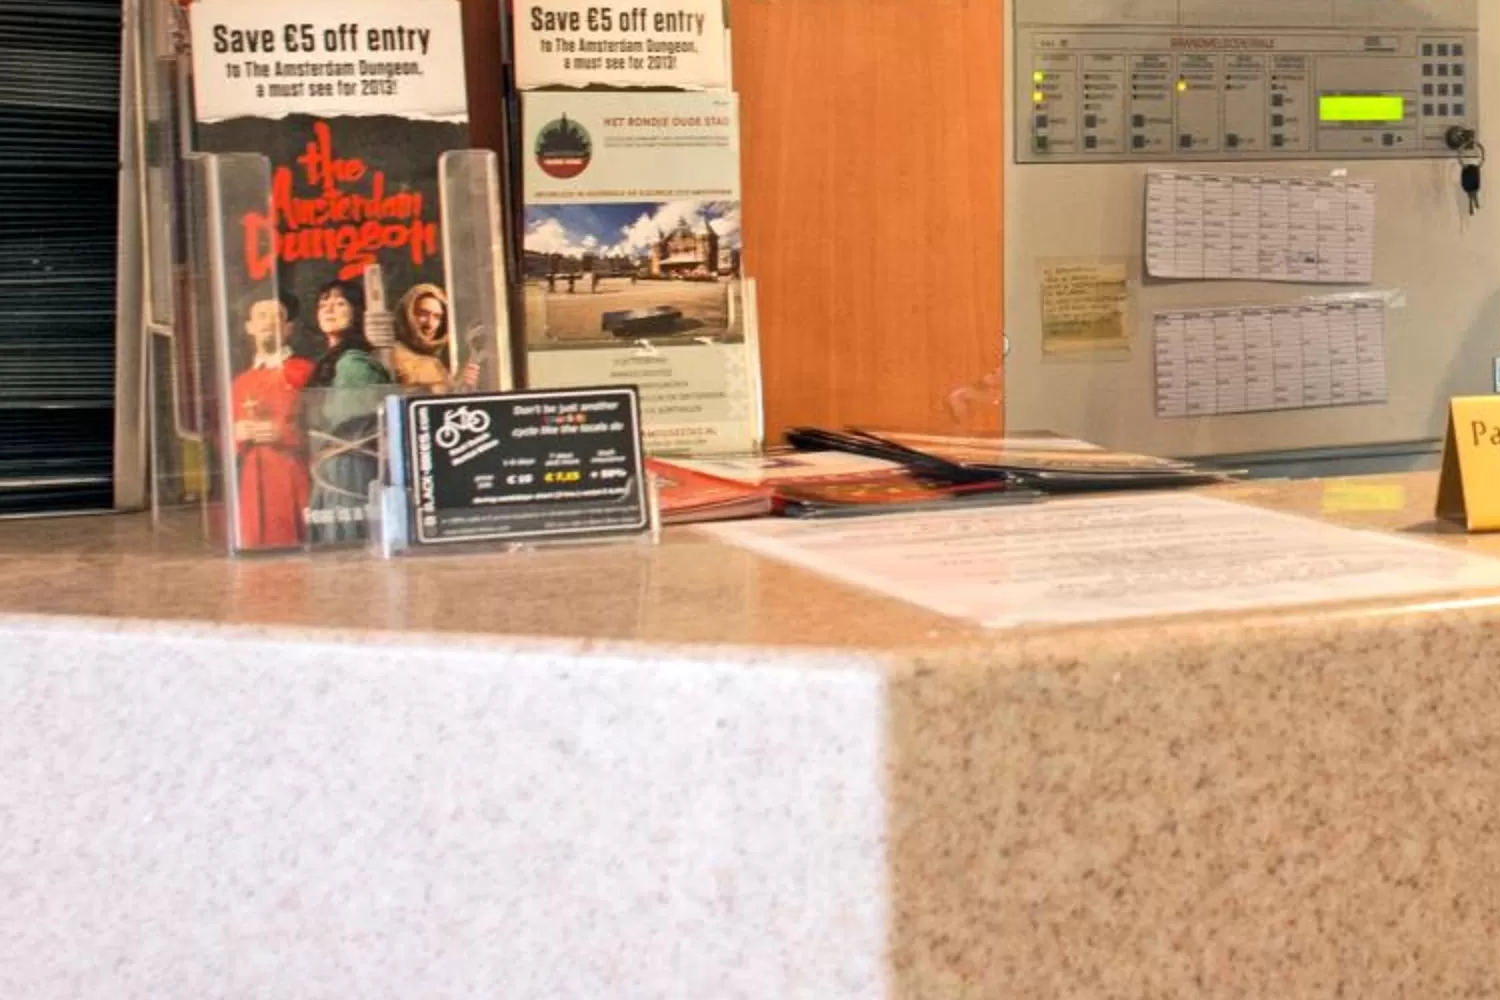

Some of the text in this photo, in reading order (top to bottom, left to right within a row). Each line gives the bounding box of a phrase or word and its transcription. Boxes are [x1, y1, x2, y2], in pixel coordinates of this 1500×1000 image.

[531, 5, 705, 36] Save €5 off entry
[213, 23, 431, 55] Save €5 off entry
[540, 39, 553, 52] to
[555, 39, 576, 53] The
[579, 38, 643, 53] Amsterdam
[226, 62, 240, 78] to
[244, 61, 270, 78] The
[275, 60, 355, 77] Amsterdam
[563, 59, 571, 69] a
[573, 57, 602, 69] must
[605, 57, 625, 69] see
[627, 56, 644, 69] for
[256, 79, 398, 98] a must see for 2013!
[297, 120, 368, 198] the
[271, 166, 423, 230] Amsterdam
[241, 211, 437, 281] Dungeon
